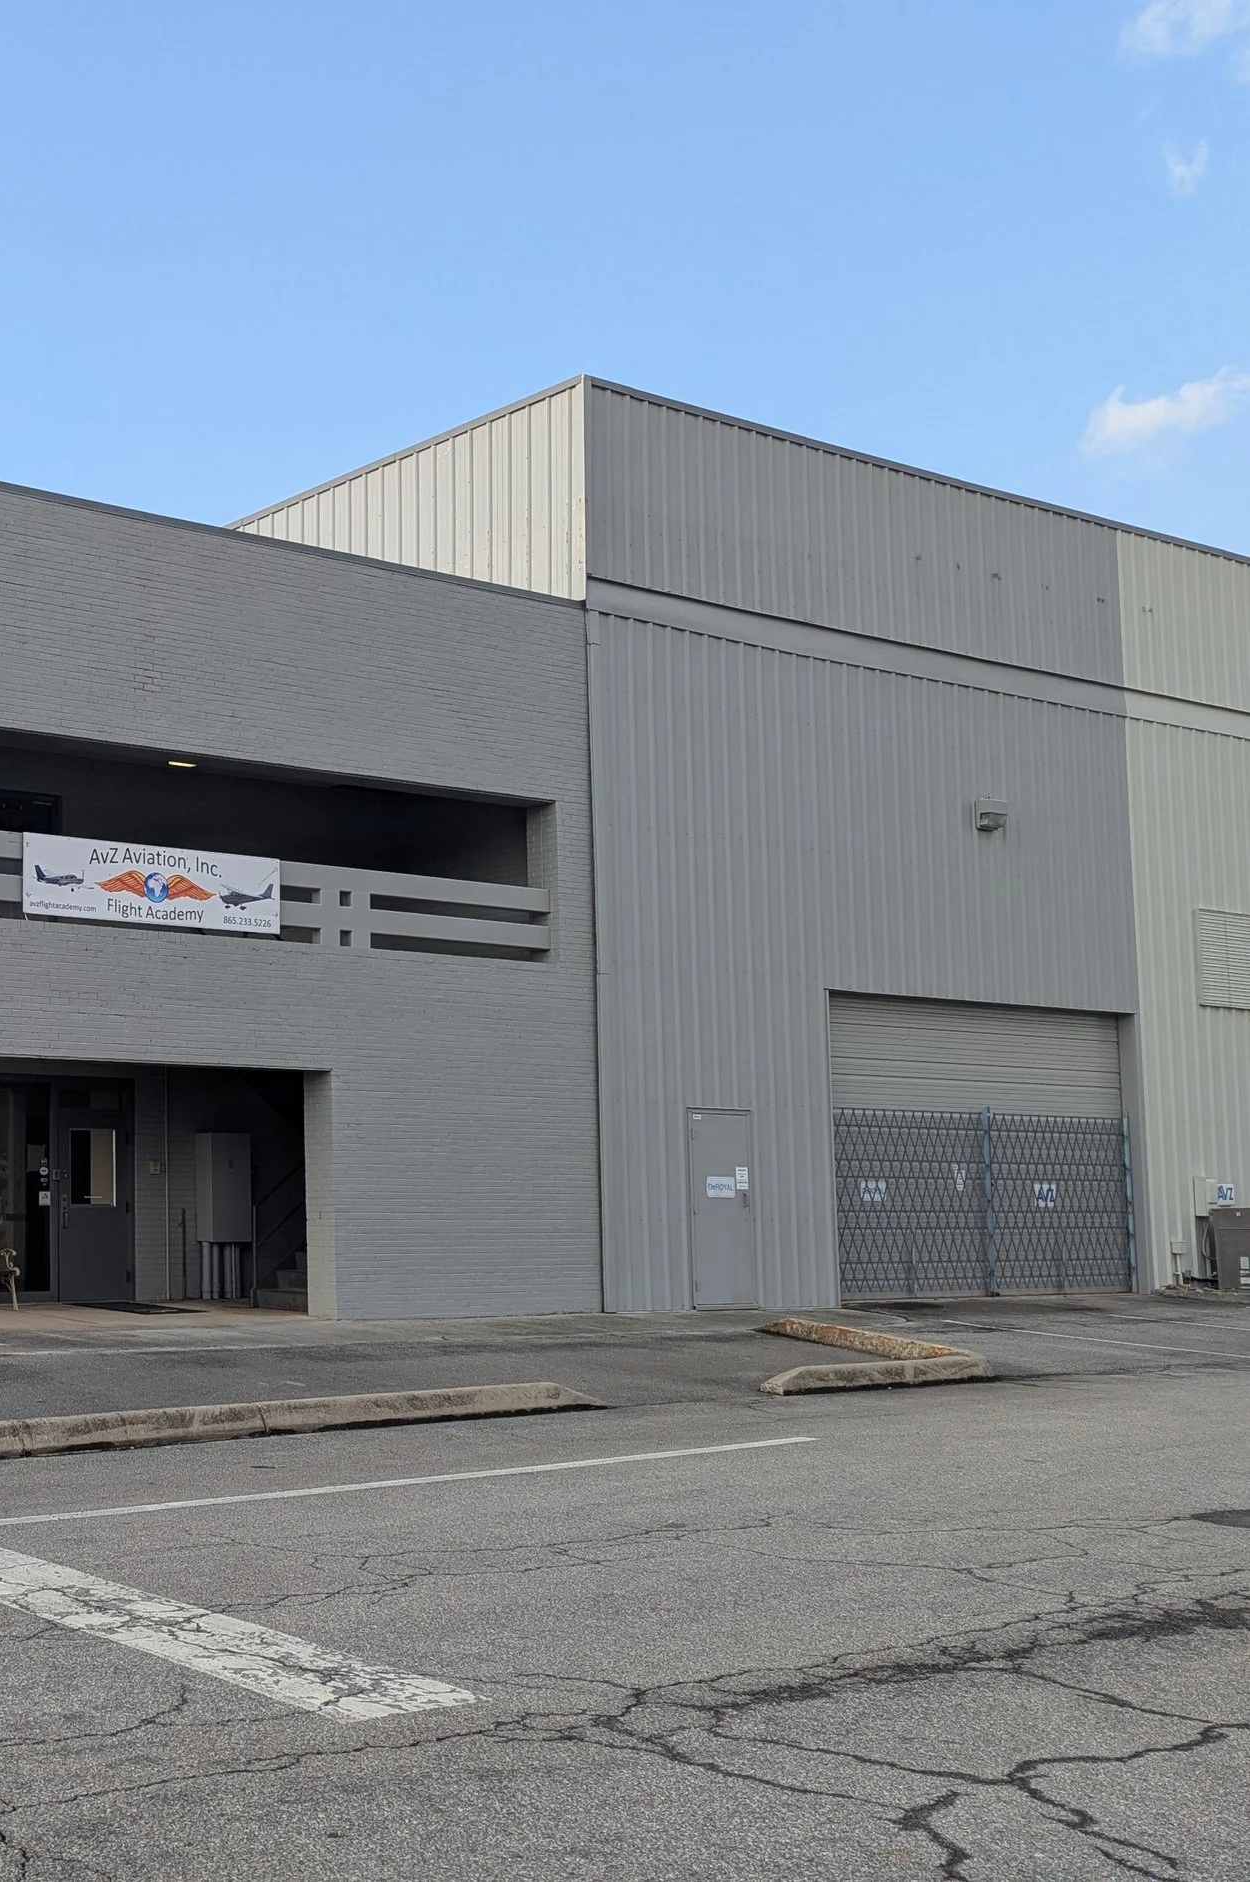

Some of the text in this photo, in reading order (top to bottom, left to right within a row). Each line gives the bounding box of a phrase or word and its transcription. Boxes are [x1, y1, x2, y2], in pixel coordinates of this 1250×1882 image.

[89, 847, 222, 878] AvZ Aviation, Inc.
[30, 901, 97, 913] avzflightacademy.com
[107, 898, 204, 923] Flight Academy
[223, 915, 272, 928] 865.233.5226
